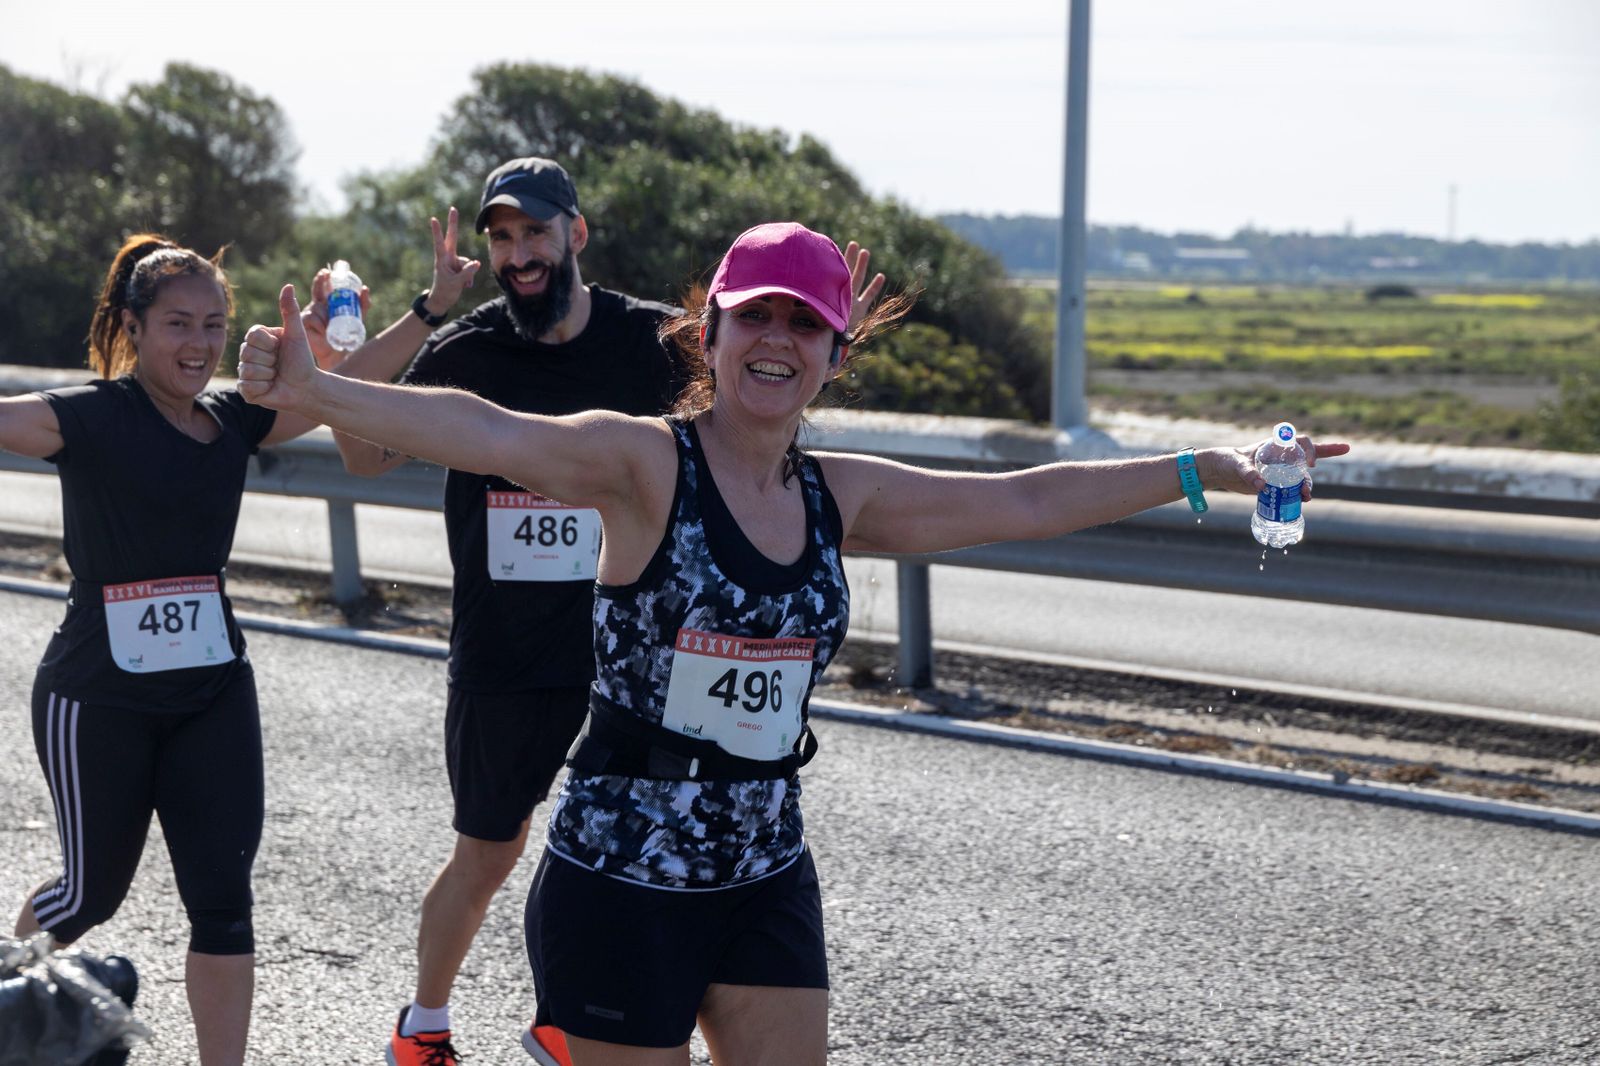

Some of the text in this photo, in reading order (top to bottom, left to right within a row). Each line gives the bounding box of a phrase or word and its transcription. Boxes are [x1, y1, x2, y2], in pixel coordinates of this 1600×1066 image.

[490, 495, 531, 506] XXXVI
[514, 515, 578, 546] 486
[106, 583, 152, 600] XXXVI
[138, 600, 200, 635] 487
[680, 633, 740, 656] XXXVI
[708, 668, 783, 713] 496
[682, 723, 703, 737] imd
[737, 721, 762, 731] GREGO
